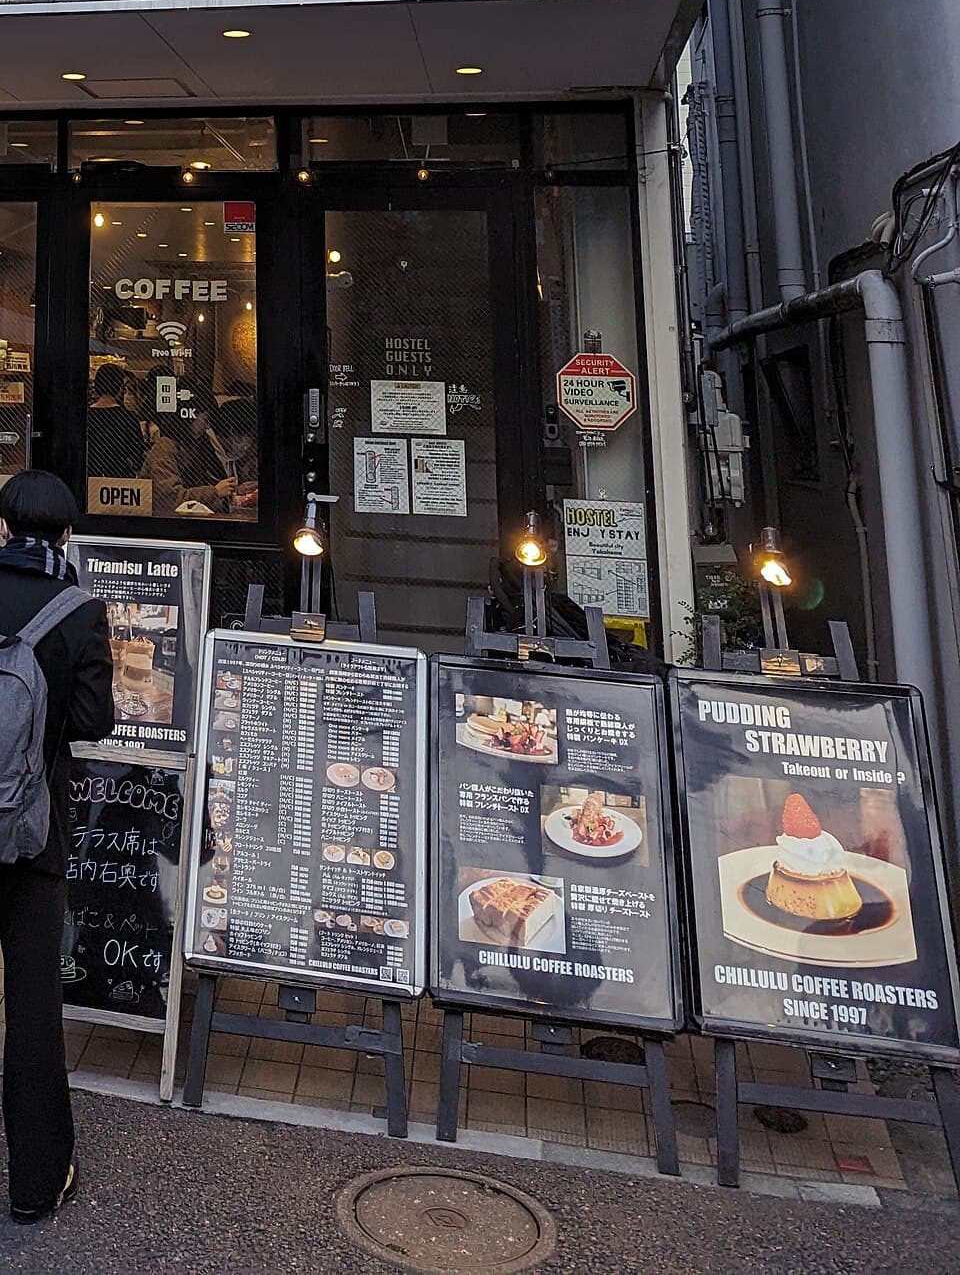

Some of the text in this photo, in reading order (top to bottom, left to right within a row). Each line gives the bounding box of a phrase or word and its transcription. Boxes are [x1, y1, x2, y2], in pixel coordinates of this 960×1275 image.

[225, 223, 254, 231] SECOM
[115, 278, 228, 302] COFFEE
[385, 337, 431, 351] HOSTEL
[151, 348, 192, 358] Free Wi-Fi
[385, 351, 432, 363] GUESTS
[386, 364, 432, 376] ONLY
[575, 358, 615, 366] SECURITY
[580, 367, 610, 375] ALERT
[576, 380, 605, 388] HOUR
[564, 388, 594, 397] VIDEO
[564, 398, 620, 407] SURVEILLANCE
[180, 408, 197, 419] OK
[99, 486, 141, 506] OPEN
[565, 506, 618, 528] HOSTEL
[87, 558, 179, 578] Tiramisu Latte
[698, 699, 792, 729] PUDDING
[138, 726, 186, 742] ROASTERS
[583, 735, 617, 745] パンケーキ
[619, 738, 629, 746] DX
[745, 729, 888, 763] STRAWBERRY
[781, 761, 906, 785] Takeout or Inside ?
[69, 777, 180, 819] WELCOME
[475, 801, 519, 812] フレンチトースト
[72, 826, 160, 856] テラス席は
[66, 854, 160, 893] 店内右奥です
[609, 907, 651, 919] チーズトースト
[104, 913, 115, 930] &
[120, 913, 158, 939] ペット
[478, 950, 635, 983] CHILLULU COFFEE ROASTERS
[714, 964, 939, 1010] CHILLULU COFFEE ROASTERS
[783, 998, 868, 1026] SINCE 1997
